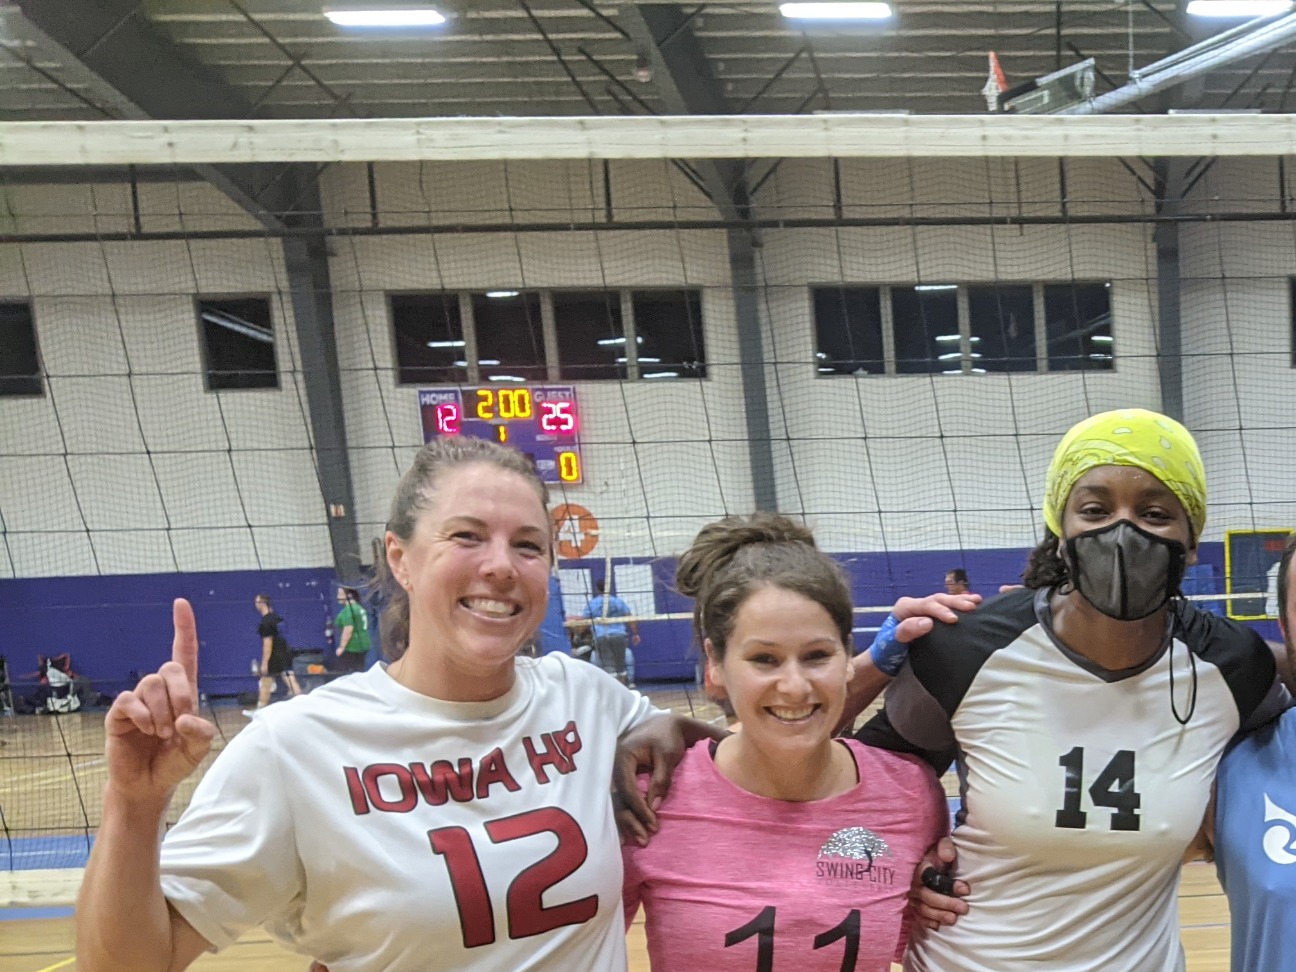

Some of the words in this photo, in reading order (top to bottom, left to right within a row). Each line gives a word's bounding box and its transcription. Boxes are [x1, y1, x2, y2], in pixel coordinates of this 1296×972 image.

[437, 405, 457, 433] 12
[541, 402, 574, 431] 25
[559, 452, 578, 481] 0
[558, 515, 586, 547] 4
[343, 746, 521, 815] IOWA
[1055, 746, 1141, 831] 14
[427, 806, 599, 949] 12
[816, 861, 863, 881] SWING
[870, 866, 896, 885] CITY
